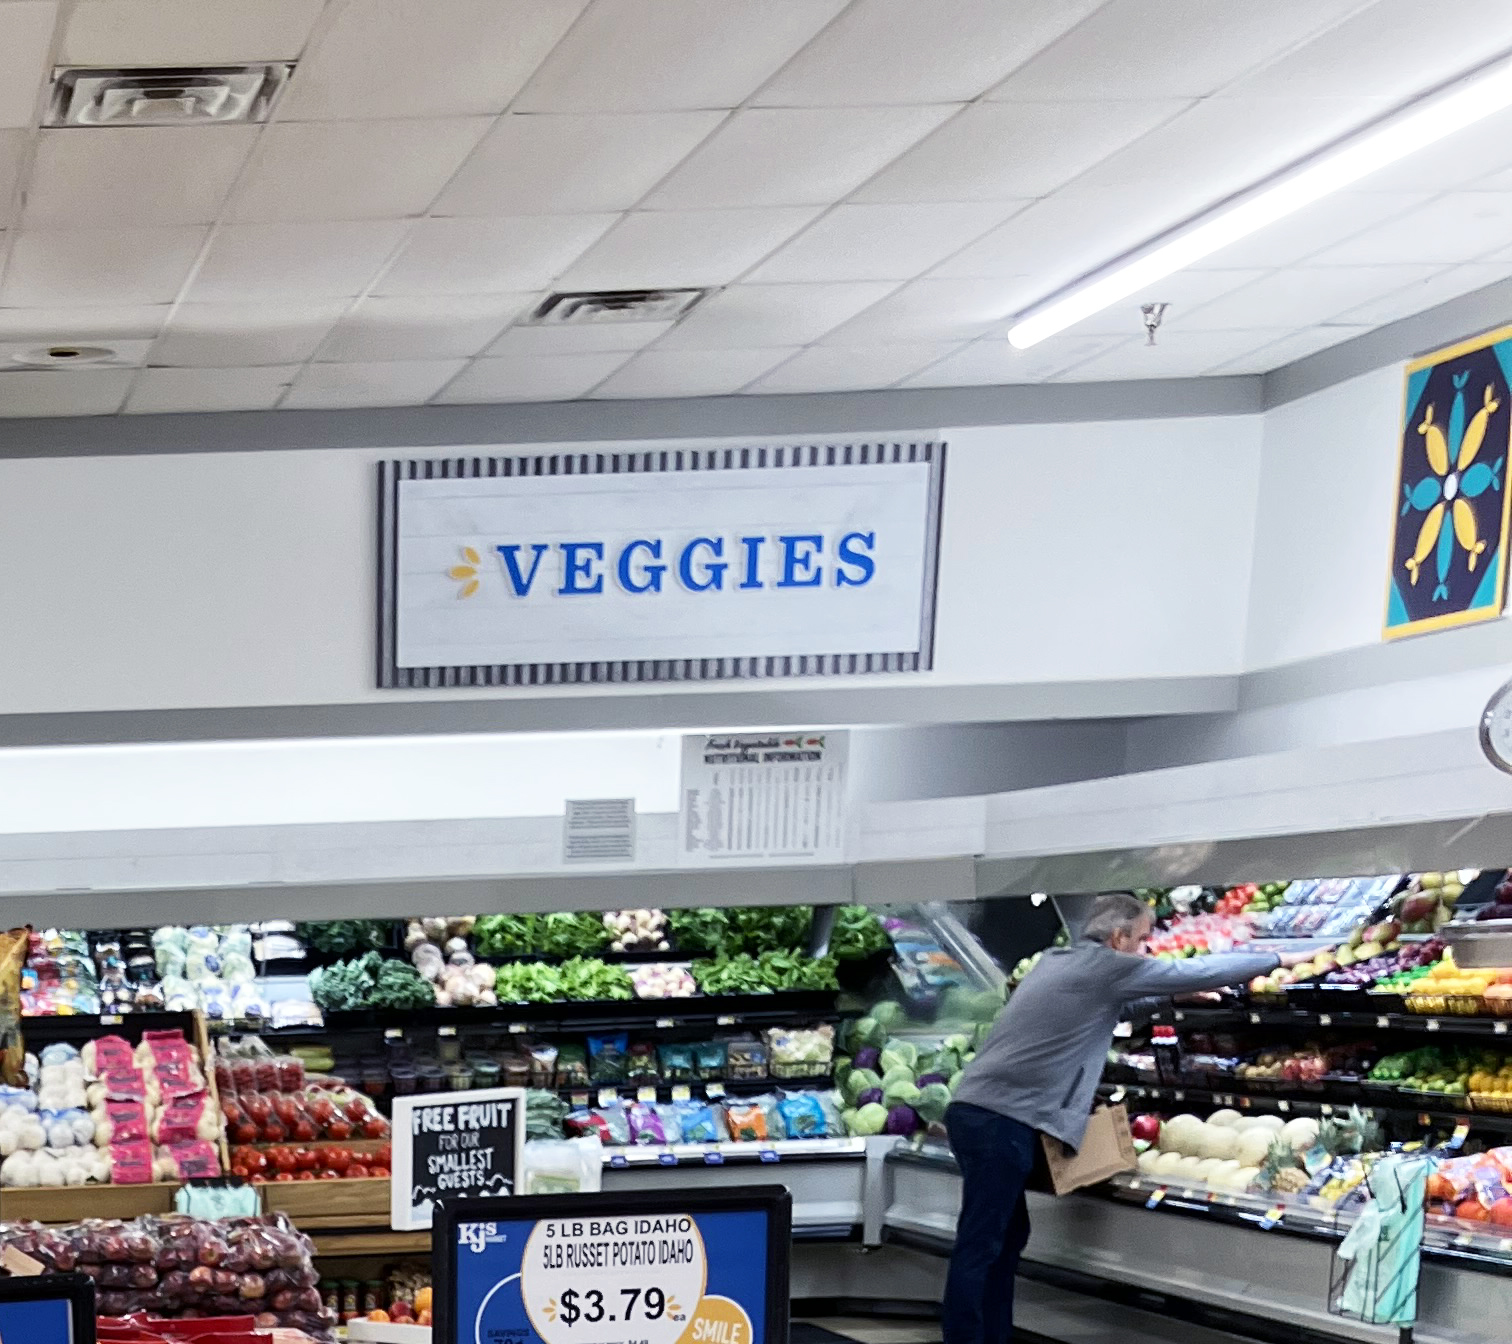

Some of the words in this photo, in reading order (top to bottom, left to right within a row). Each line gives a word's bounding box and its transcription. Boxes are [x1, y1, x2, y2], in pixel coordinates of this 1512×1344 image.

[495, 530, 879, 598] VEGGIES
[412, 1105, 456, 1135] FREE
[457, 1102, 513, 1130] FRUIT
[439, 1133, 460, 1150] FOR
[461, 1131, 481, 1149] OUR
[427, 1146, 495, 1175] SMALLEST
[437, 1170, 486, 1191] GUESTS
[546, 1224, 555, 1238] 5
[560, 1222, 584, 1238] LB
[589, 1220, 628, 1236] BAG
[633, 1217, 692, 1235] IDAHO
[542, 1244, 564, 1270] 5LB
[566, 1241, 610, 1268] RUSSET
[612, 1240, 656, 1267] POTATO
[657, 1238, 695, 1265] IDAHO
[559, 1286, 666, 1328] $3.79
